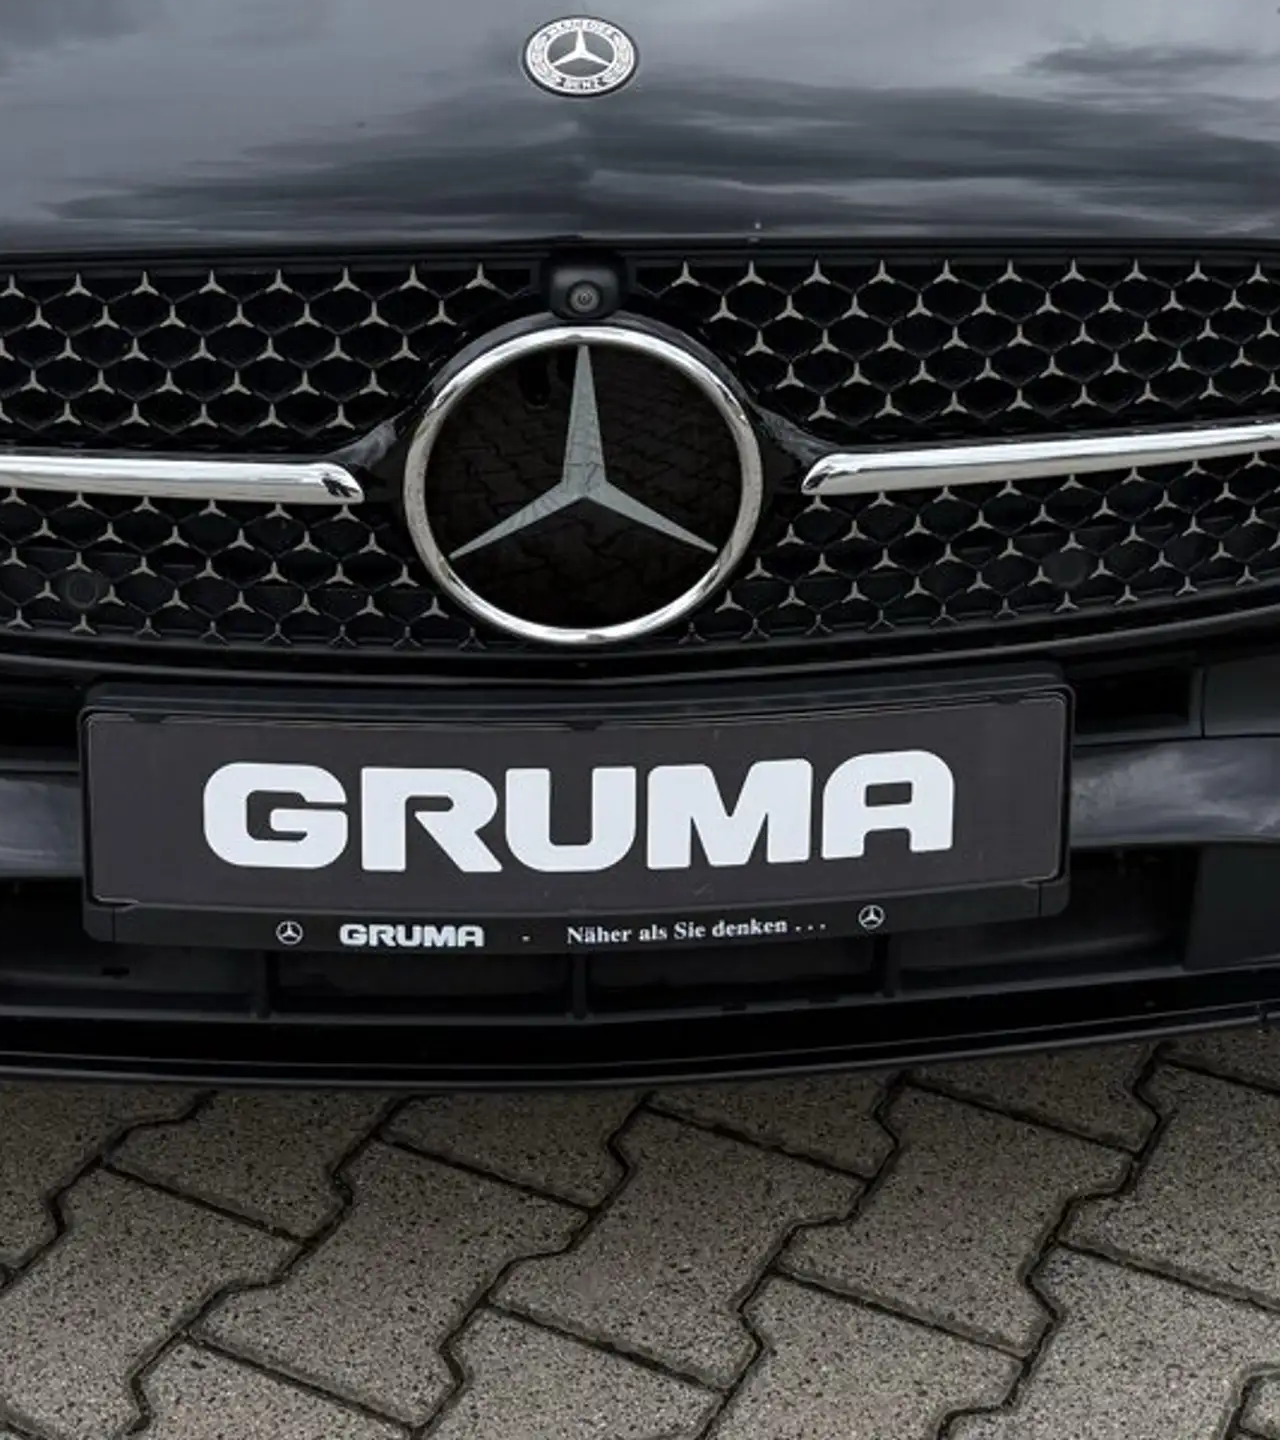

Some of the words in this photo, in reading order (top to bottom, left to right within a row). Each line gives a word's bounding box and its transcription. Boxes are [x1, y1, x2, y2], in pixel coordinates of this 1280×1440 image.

[203, 750, 955, 872] GRUMA
[339, 924, 485, 947] GRUMA
[567, 924, 632, 944] Näher
[639, 924, 668, 942] als
[674, 921, 706, 941] Sie
[712, 917, 788, 937] denken
